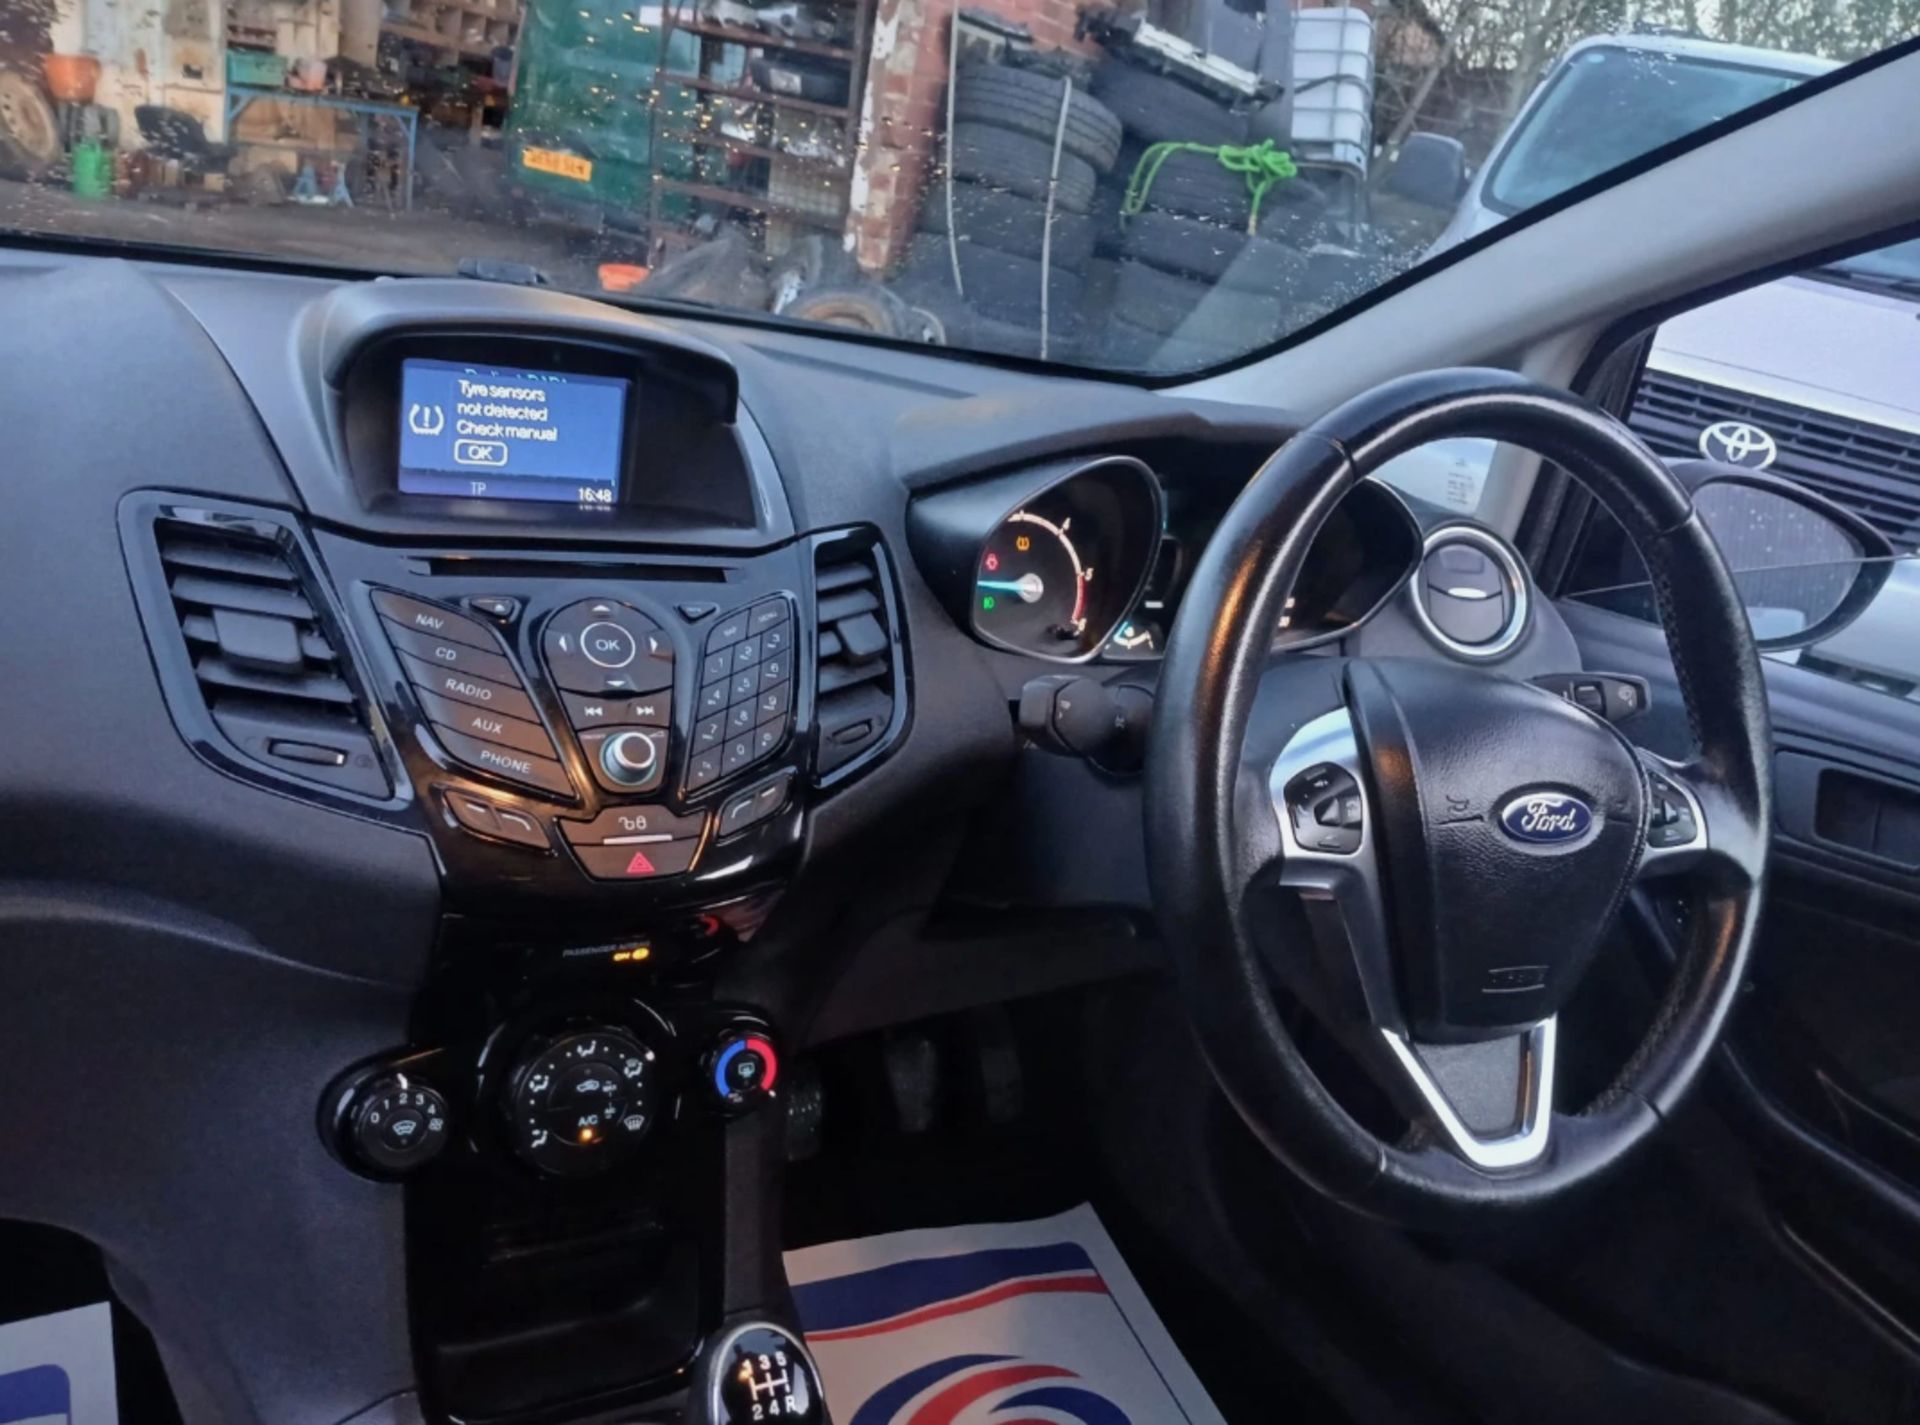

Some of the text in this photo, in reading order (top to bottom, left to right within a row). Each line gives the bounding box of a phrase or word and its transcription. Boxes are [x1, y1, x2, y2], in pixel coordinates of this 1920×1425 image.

[458, 379, 546, 402] Tyre sensors
[457, 403, 548, 421] not detected
[456, 420, 558, 441] Check manual
[467, 446, 493, 460] OK
[470, 481, 487, 496] TP
[578, 487, 612, 503] 16:48
[415, 613, 444, 630] NAV
[435, 646, 457, 662] CD
[595, 638, 621, 652] OK
[445, 678, 492, 701] RADIO
[471, 716, 503, 735] AUX
[480, 750, 532, 773] PHONE
[1521, 799, 1577, 832] Ford
[370, 1092, 436, 1124] 0 1 2 3 4
[578, 1114, 598, 1127] A/C
[758, 1354, 771, 1371] 3
[775, 1350, 787, 1367] 5
[752, 1395, 797, 1421] 2 4 R
